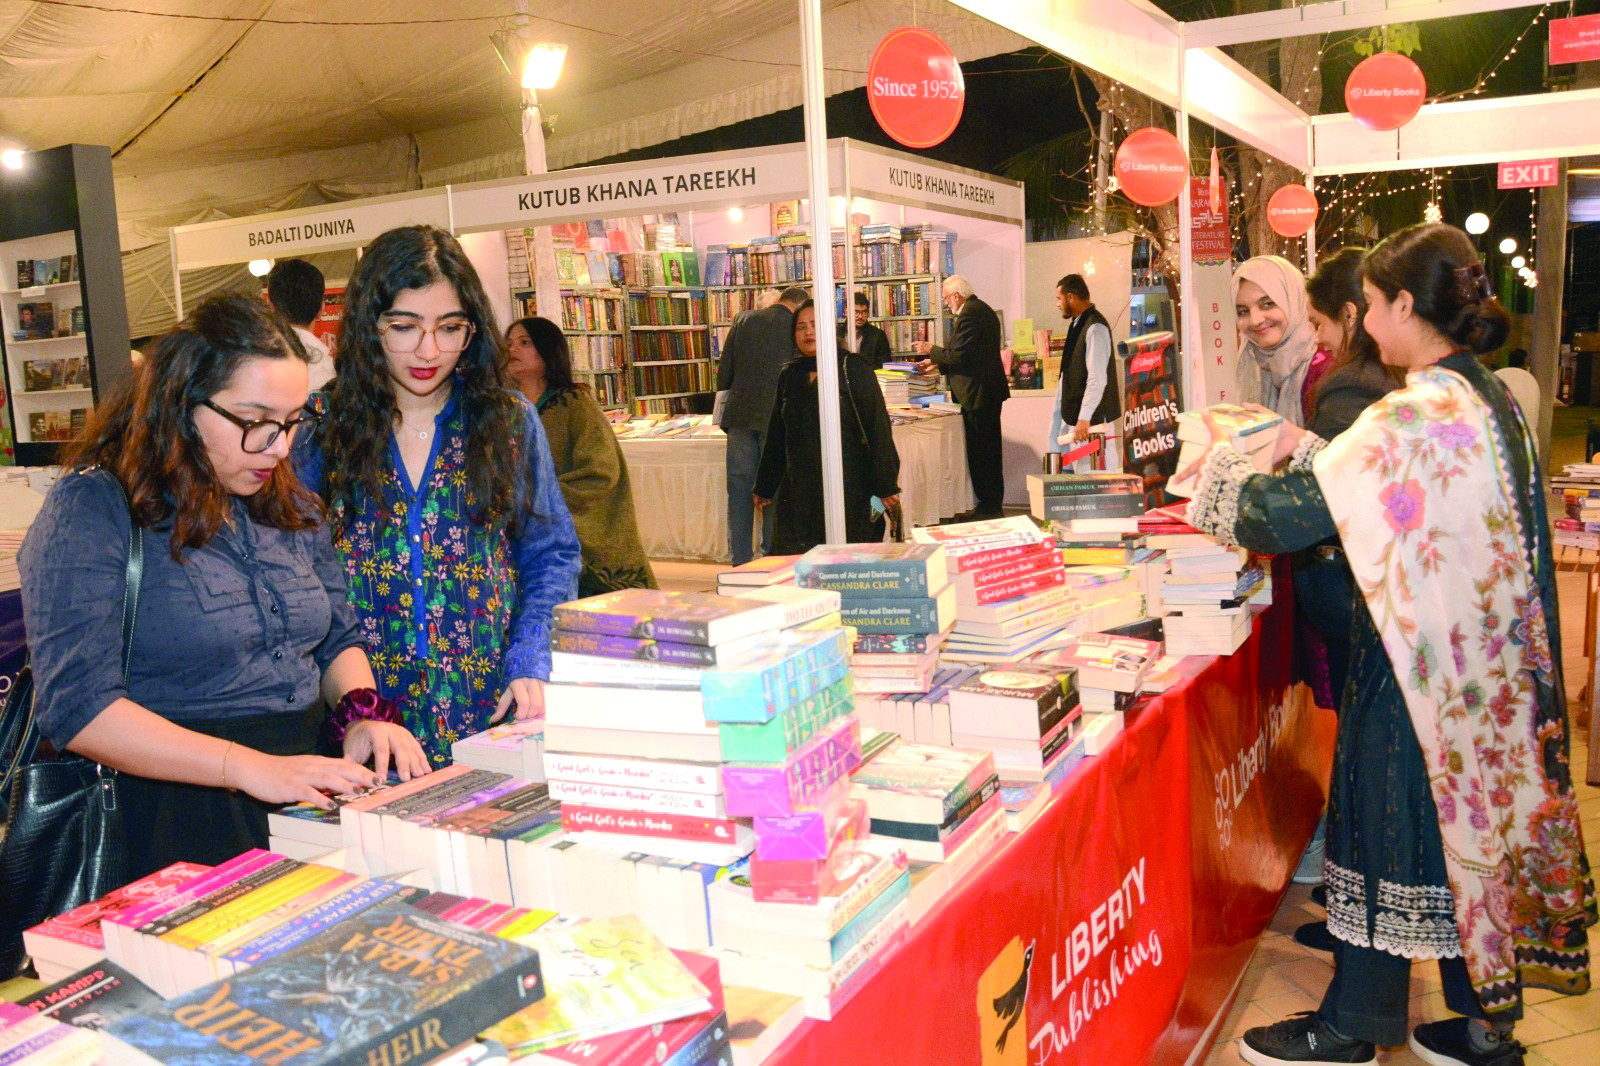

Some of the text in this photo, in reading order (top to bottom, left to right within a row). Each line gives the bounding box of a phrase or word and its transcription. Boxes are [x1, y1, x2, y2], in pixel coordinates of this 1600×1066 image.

[873, 76, 959, 99] Since 1952
[1363, 87, 1420, 98] Liberty Books
[1131, 162, 1184, 173] Liberty Books
[1502, 164, 1553, 185] EXIT
[518, 167, 756, 210] KUTUB KHANA TAREEKH
[889, 167, 995, 206] KUTUB KHANA TAREEKH
[248, 218, 356, 247] BADALTI DUNIYA
[1192, 239, 1226, 250] FESTIVAL
[1123, 399, 1179, 432] Children's
[1132, 431, 1176, 459] Books
[1051, 504, 1075, 512] ORHAN
[1075, 503, 1097, 511] PAMUK
[820, 580, 900, 590] CASSANDRA CLARE
[840, 571, 847, 579] of
[842, 617, 911, 626] SSANDRA CLARE
[959, 685, 1035, 698] MURAKAMI
[1231, 726, 1268, 810] Liberty
[371, 915, 484, 968] TAHIR
[1051, 856, 1146, 1001] LIBERTY
[339, 931, 463, 985] SABAA
[45, 970, 105, 1004] KAMPF
[1029, 929, 1162, 1066] Publishing
[173, 982, 322, 1066] HEIR
[368, 1017, 450, 1066] HEIR
